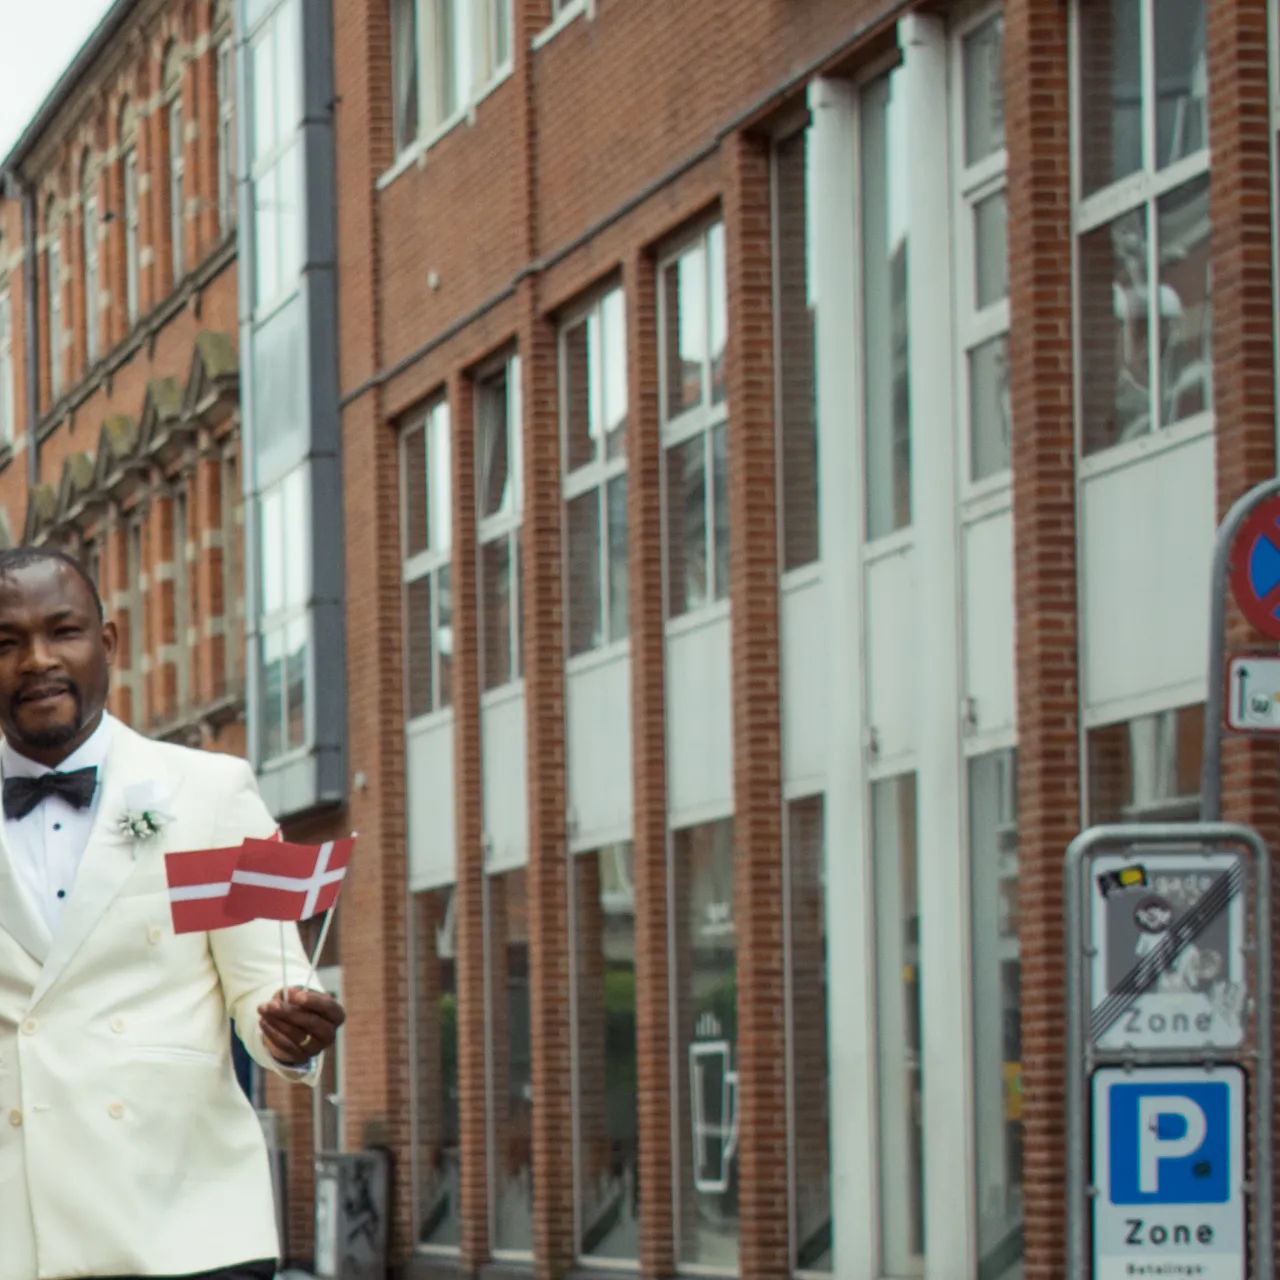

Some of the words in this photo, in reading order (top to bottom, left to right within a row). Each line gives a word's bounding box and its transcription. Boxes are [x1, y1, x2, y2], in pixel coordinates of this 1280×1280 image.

[1124, 1008, 1213, 1034] Zone
[1136, 1094, 1207, 1194] P
[1124, 1218, 1215, 1245] Zone
